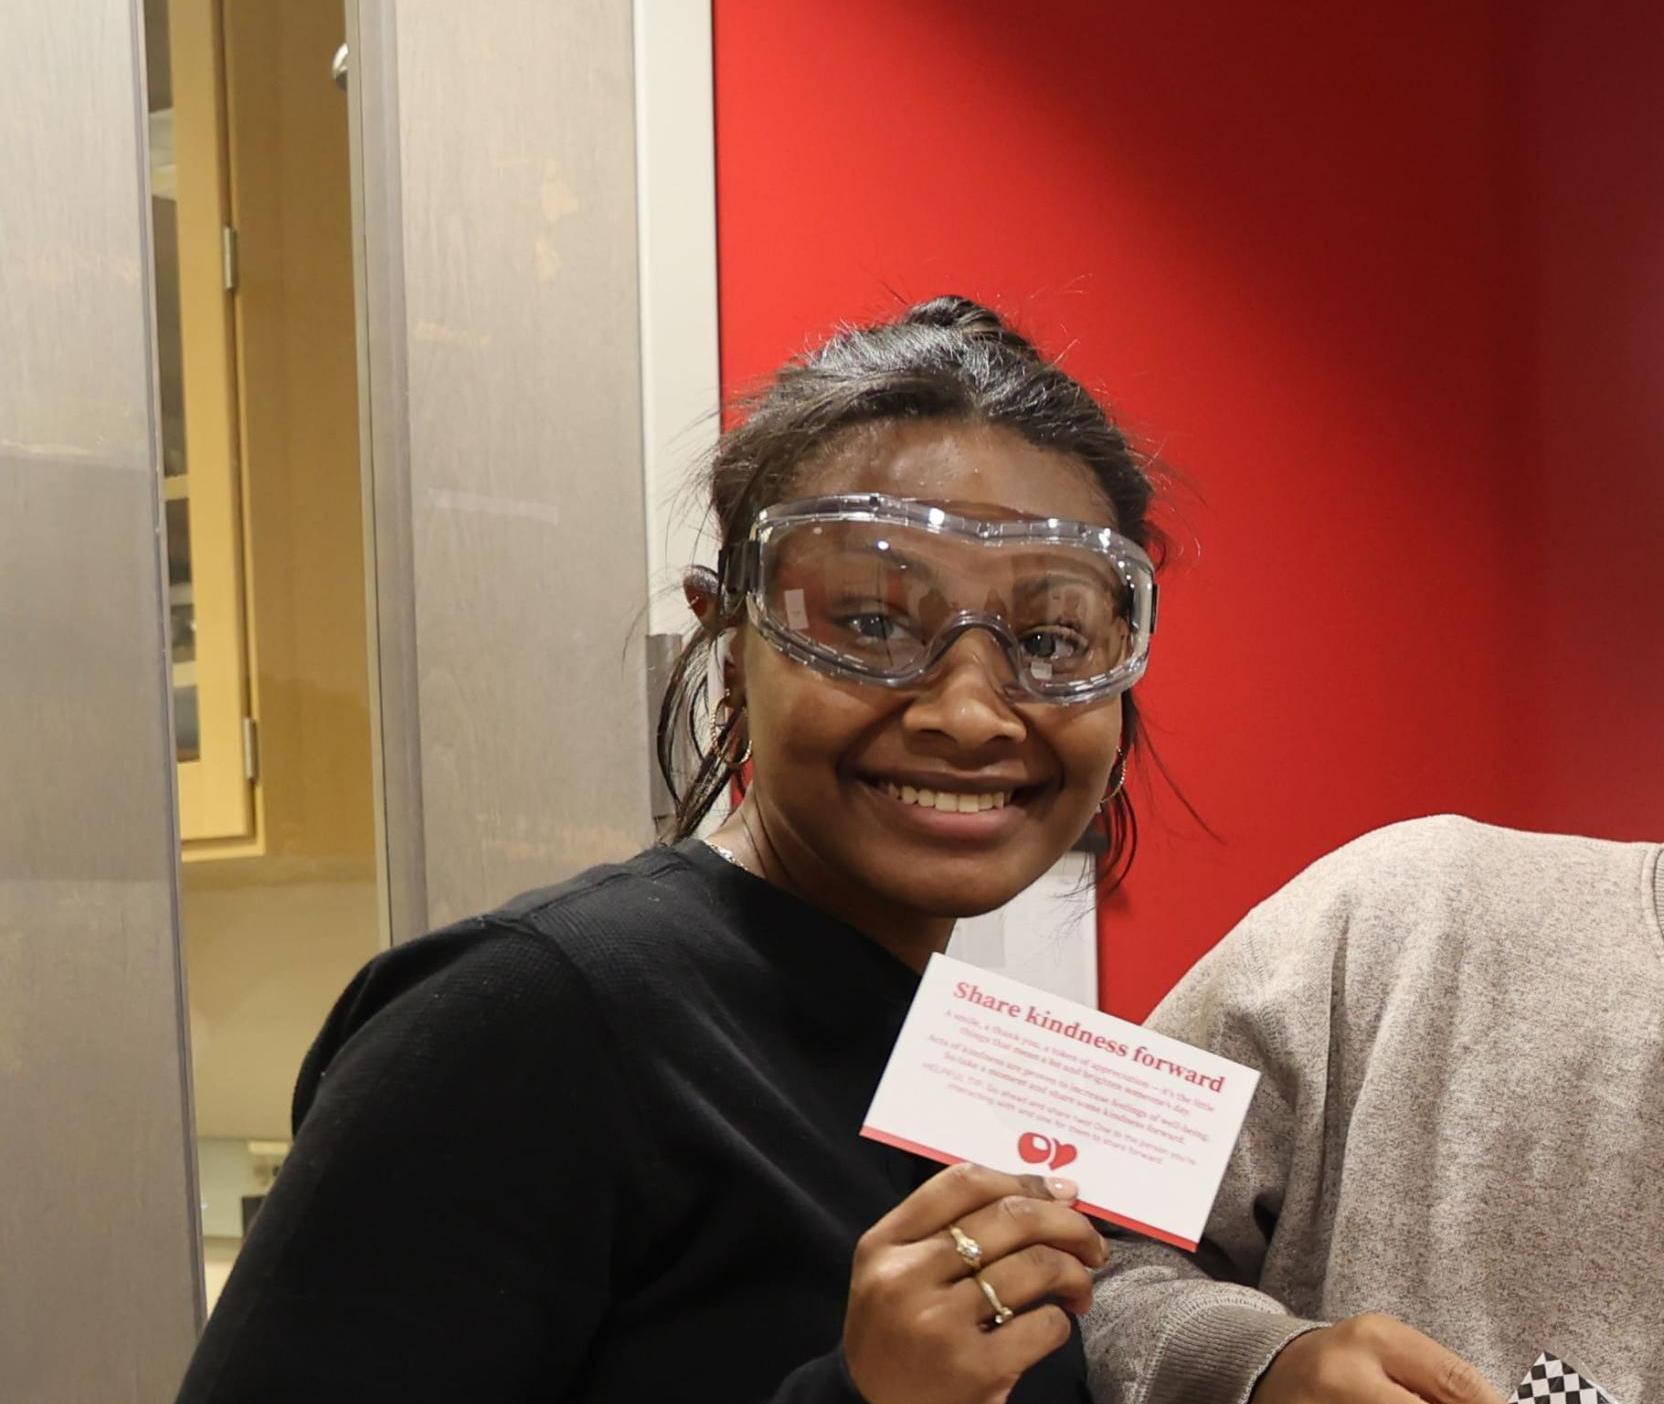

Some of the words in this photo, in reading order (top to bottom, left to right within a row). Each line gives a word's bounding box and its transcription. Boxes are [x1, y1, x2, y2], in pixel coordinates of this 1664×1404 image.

[954, 981, 1022, 1018] Share
[1024, 1006, 1129, 1057] kindness
[1132, 1046, 1225, 1092] forward
